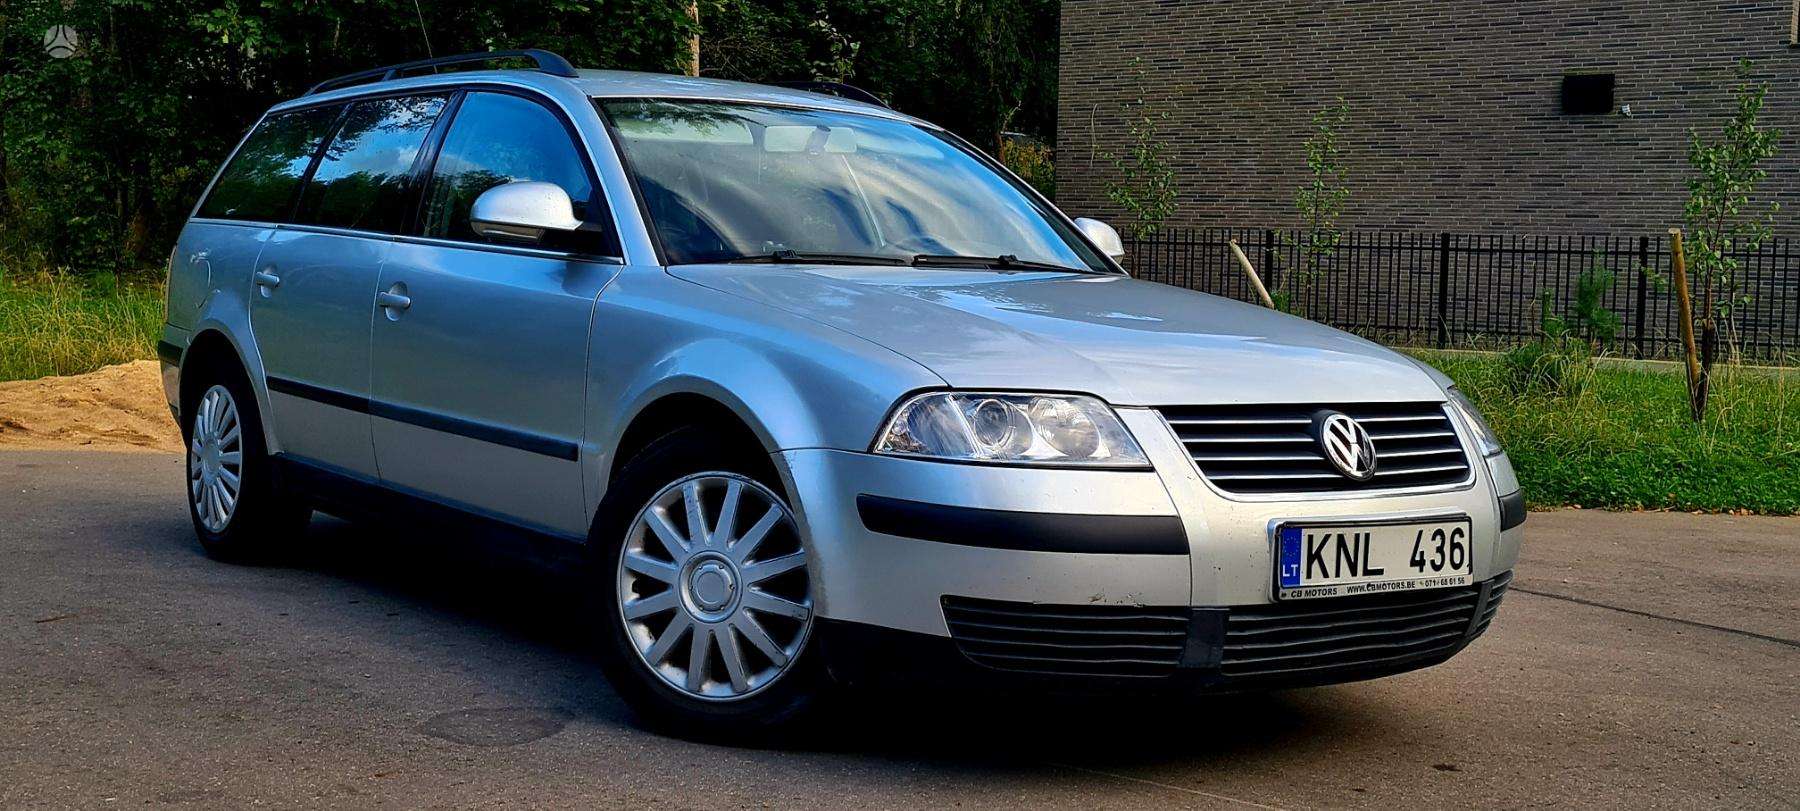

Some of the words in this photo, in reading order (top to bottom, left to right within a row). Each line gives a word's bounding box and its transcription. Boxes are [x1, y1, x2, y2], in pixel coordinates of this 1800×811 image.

[1306, 532, 1384, 579] KNL
[1410, 527, 1465, 573] 436
[1283, 564, 1298, 577] LT
[1291, 590, 1302, 598] CB
[1304, 588, 1337, 597] MOTORS
